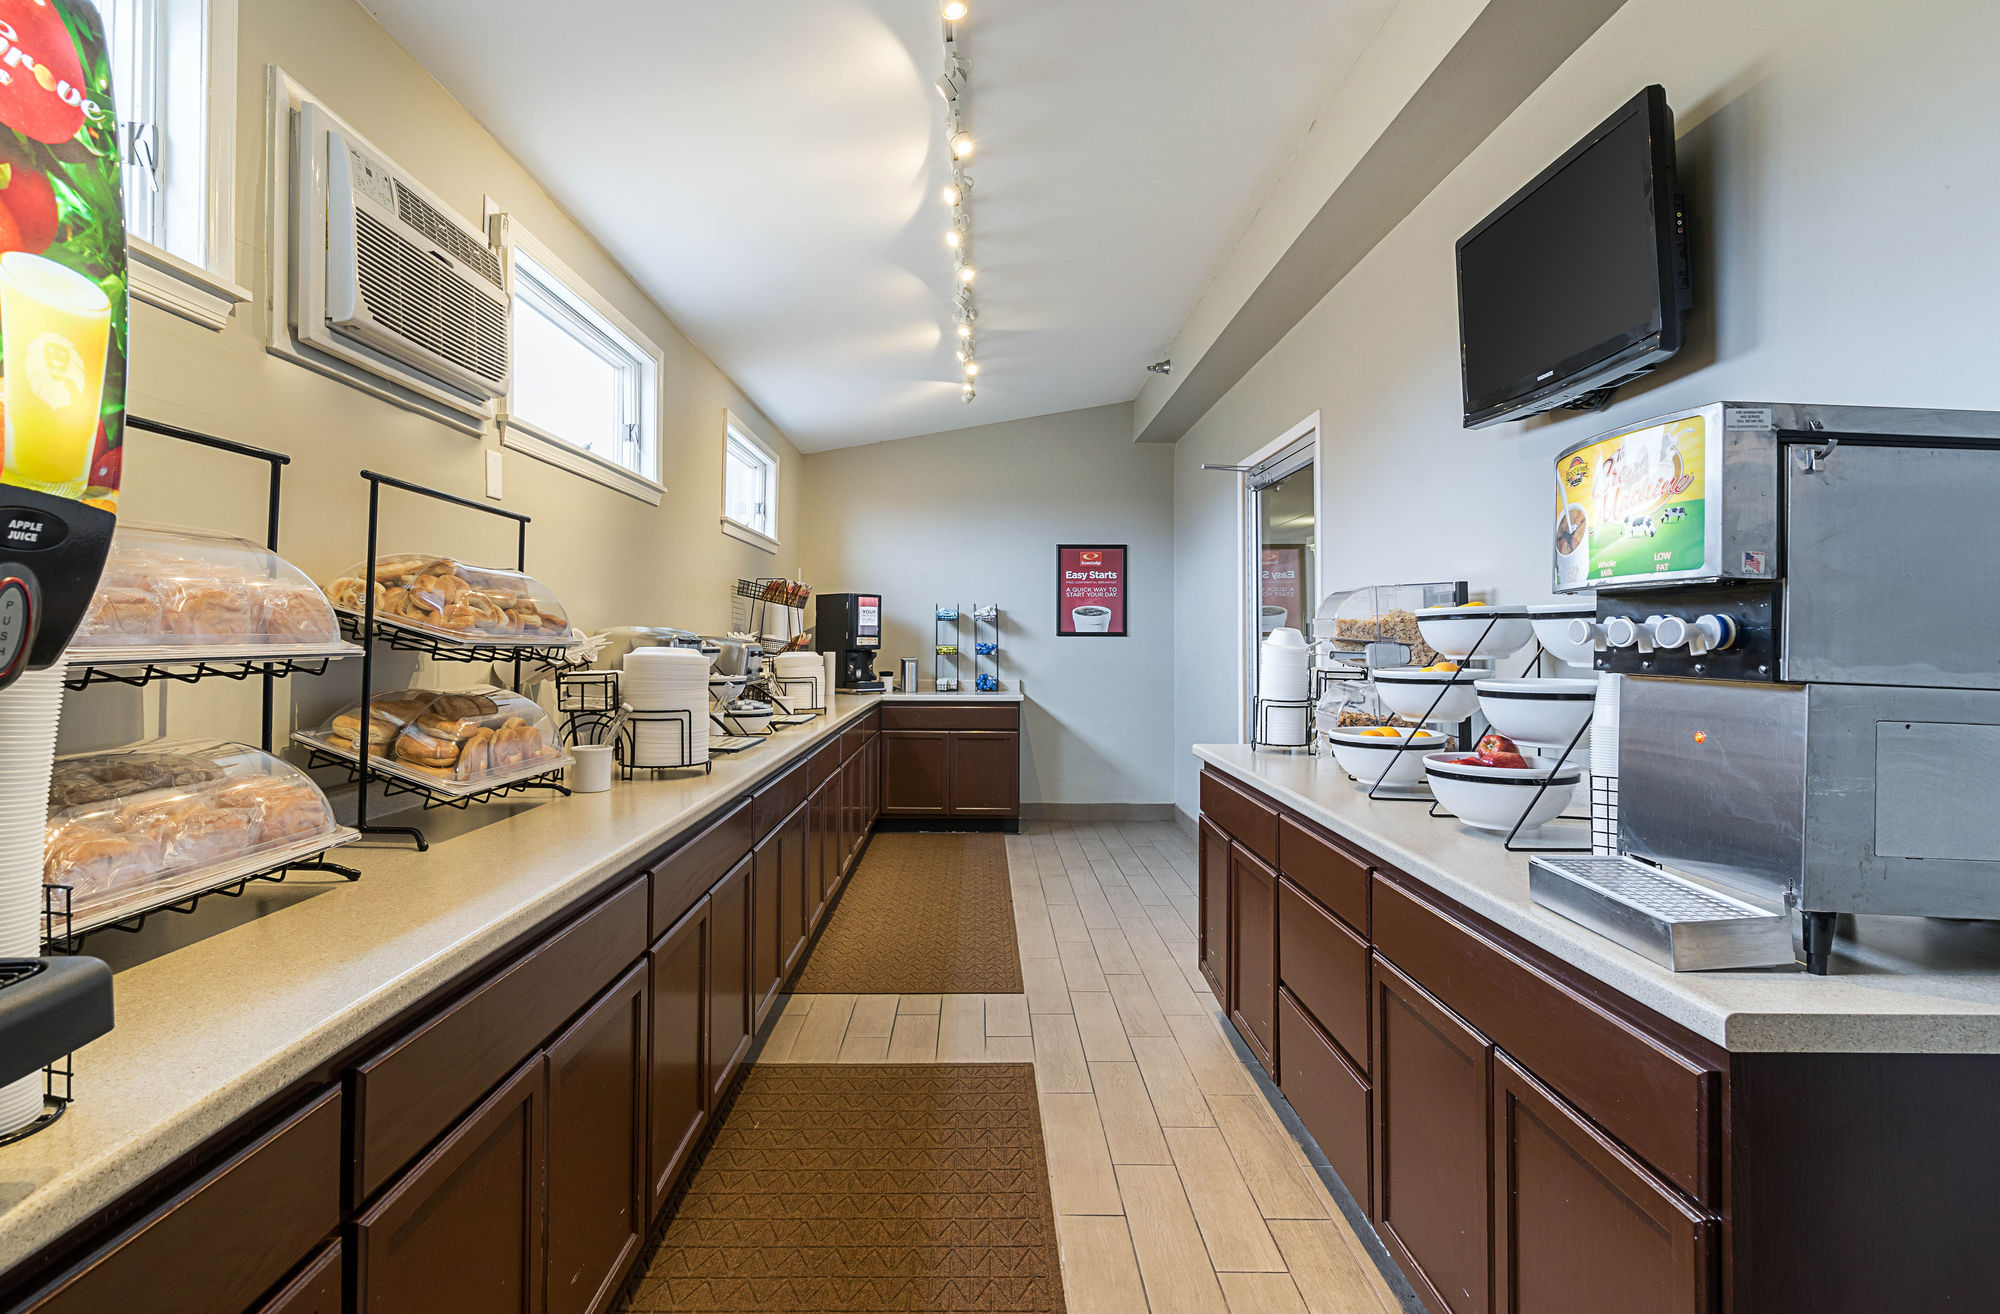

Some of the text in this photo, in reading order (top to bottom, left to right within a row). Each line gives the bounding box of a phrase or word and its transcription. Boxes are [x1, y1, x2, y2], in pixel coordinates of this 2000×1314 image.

[8, 519, 43, 532] APPLE
[7, 531, 39, 543] JUICE
[1654, 551, 1672, 561] LOW
[1598, 560, 1617, 568] Whole
[1656, 563, 1670, 572] FAT
[1065, 570, 1117, 580] Easy Starts
[1600, 568, 1613, 577] Milk
